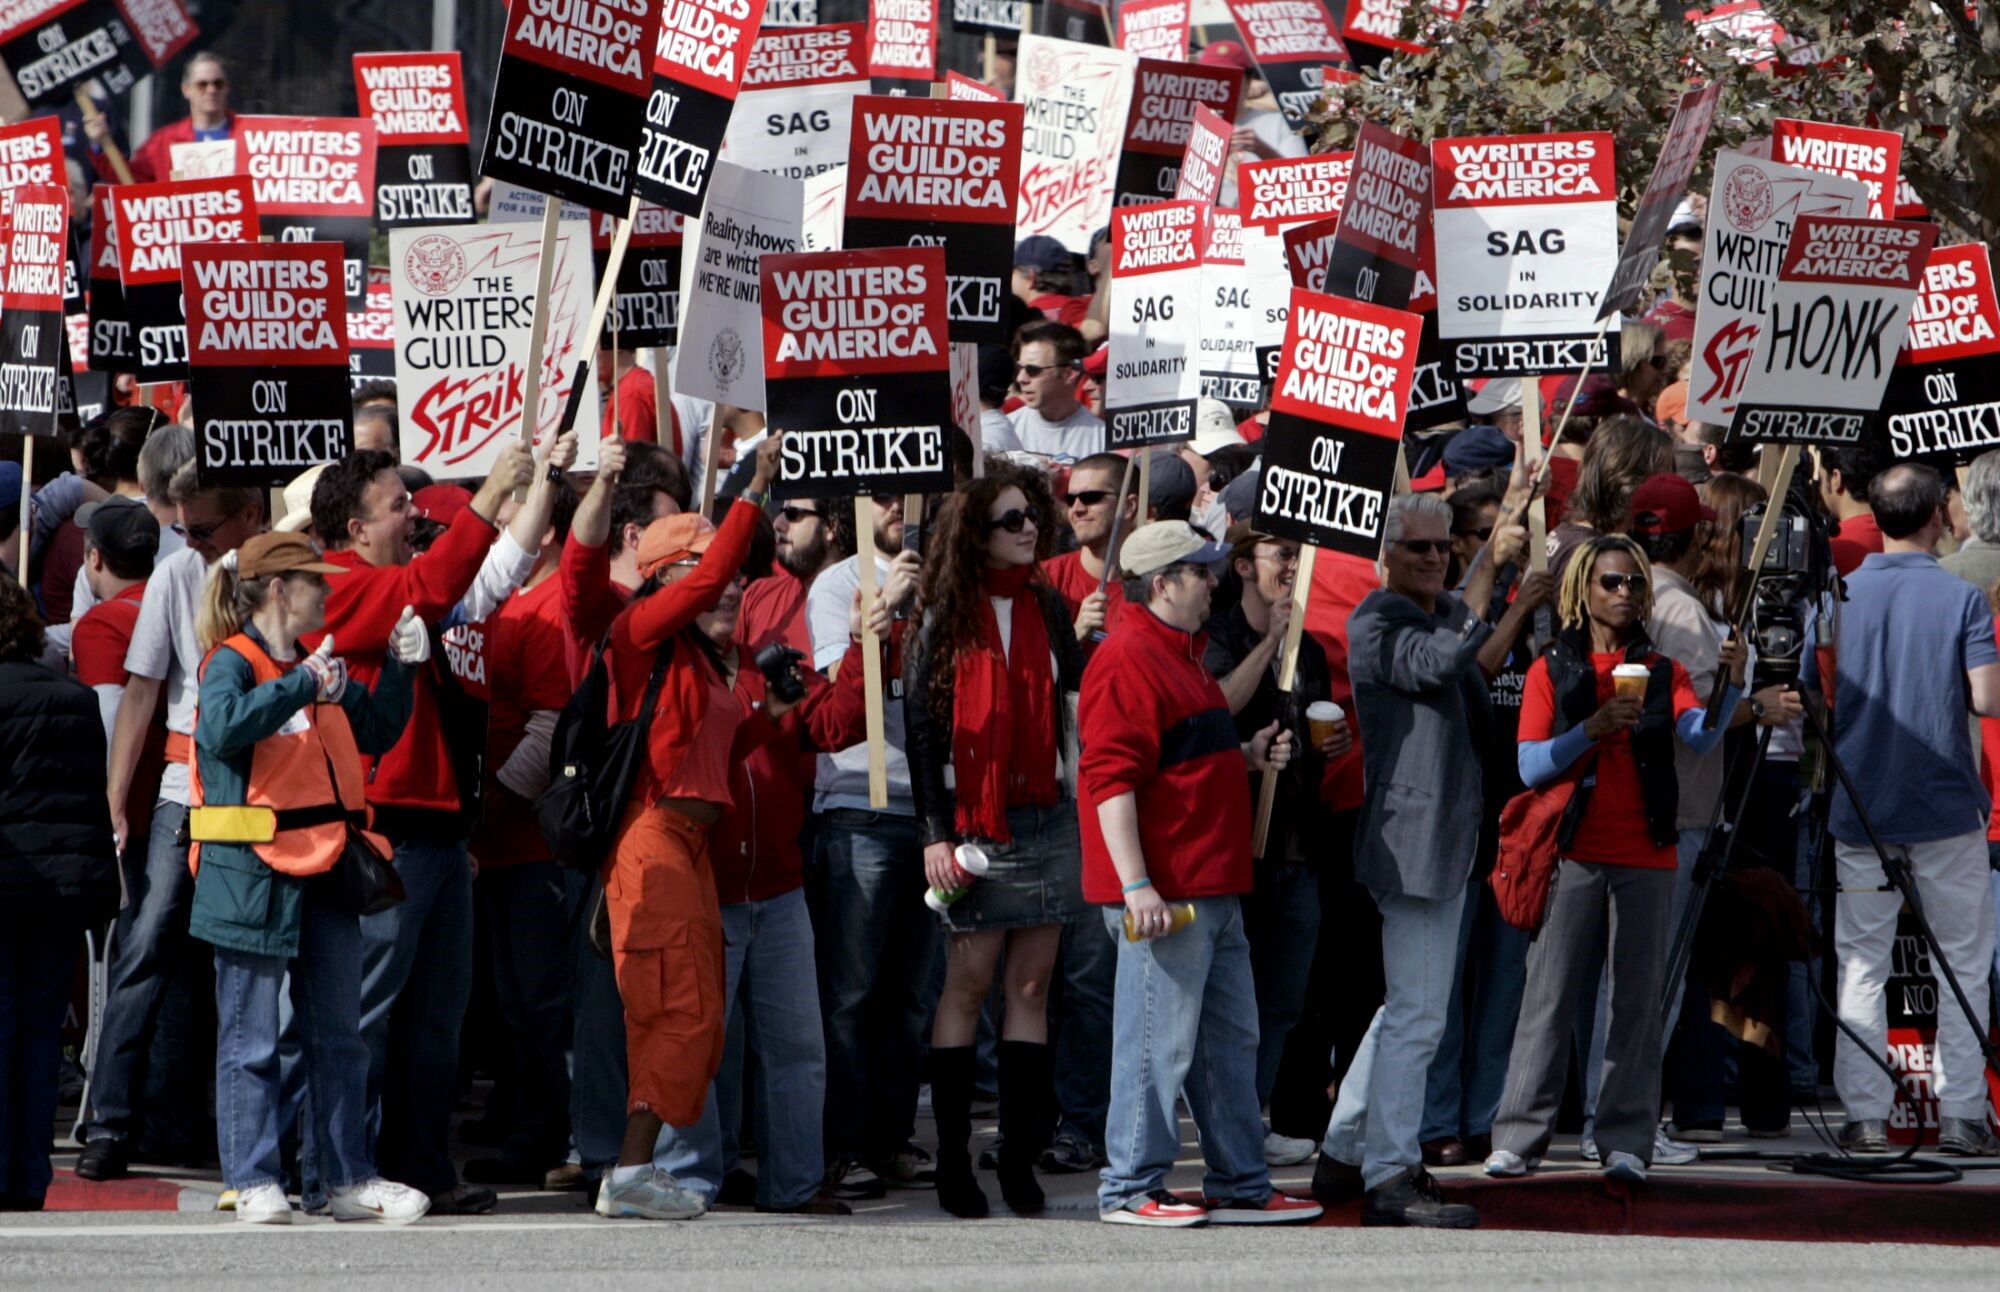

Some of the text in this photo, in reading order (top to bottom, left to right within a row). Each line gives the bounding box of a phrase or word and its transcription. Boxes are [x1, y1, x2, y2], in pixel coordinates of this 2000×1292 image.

[528, 0, 613, 35] GUILD
[613, 20, 642, 46] OF
[1124, 3, 1186, 33] WRITERS
[1234, 1, 1323, 19] WRITERS
[713, 23, 740, 48] OF
[875, 21, 929, 43] GUILD OF
[1124, 27, 1183, 52] GUILD OF
[1249, 16, 1328, 37] GUILD OF
[515, 14, 643, 80] AMERICA
[871, 43, 931, 68] AMERICA
[1256, 33, 1344, 54] AMERICA
[17, 26, 118, 99] STRIKE
[744, 49, 848, 70] GUILD OF
[361, 66, 452, 89] WRITERS
[1141, 71, 1231, 101] WRITERS
[370, 89, 453, 113] GUILD OF
[552, 87, 588, 127] ON
[1063, 85, 1086, 101] THE
[372, 111, 462, 134] AMERICA
[646, 90, 680, 127] ON
[767, 110, 830, 135] SAG
[1023, 95, 1097, 134] WRITERS
[244, 131, 361, 156] WRITERS
[864, 113, 1005, 149] WRITERS
[1022, 126, 1076, 160] GUILD
[495, 112, 630, 196] STRIKE
[868, 144, 1000, 177] GUILD OF
[1450, 139, 1596, 163] WRITERS
[1782, 135, 1887, 174] WRITERS
[29, 163, 52, 184] OF
[249, 155, 357, 179] GUILD OF
[408, 154, 434, 180] ON
[1361, 139, 1431, 195] WRITERS
[1454, 160, 1590, 182] GUILD OF
[379, 184, 472, 221] STRIKE
[509, 191, 544, 203] ACTING
[856, 174, 1007, 208] AMERICA
[1253, 181, 1333, 201] GUILD
[1355, 172, 1422, 222] GUILD OF
[1448, 177, 1600, 200] AMERICA
[13, 203, 63, 233] WRITERS
[121, 190, 243, 223] WRITERS
[497, 202, 517, 213] FOR
[1121, 205, 1196, 232] WRITERS
[131, 219, 243, 247] GUILD OF
[705, 211, 796, 254] Reality shows
[1123, 228, 1193, 251] GUILD OF
[1344, 200, 1418, 254] AMERICA
[1807, 223, 1920, 247] WRITERS
[12, 233, 60, 264] GUILD OF
[704, 247, 722, 266] are
[1119, 242, 1196, 270] AMERICA
[1486, 228, 1566, 257] SAG
[1804, 242, 1909, 264] GUILD OF
[7, 264, 60, 294] AMERICA
[193, 260, 328, 290] WRITERS
[473, 276, 513, 293] THE
[640, 259, 667, 286] ON
[699, 269, 731, 298] WE'RE
[773, 264, 928, 300] WRITERS
[1355, 266, 1380, 303] ON
[1519, 271, 1536, 282] IN
[1791, 258, 1911, 281] AMERICA
[203, 291, 326, 320] GUILD OF
[782, 299, 924, 331] GUILD OF
[1132, 295, 1174, 323] SAG
[1457, 291, 1600, 312] SOLIDARITY
[1952, 294, 1979, 316] OF
[21, 325, 40, 358] ON
[199, 321, 339, 350] AMERICA
[775, 326, 938, 363] AMERICA
[1146, 338, 1155, 349] IN
[1297, 306, 1406, 360] WRITERS
[1765, 295, 1899, 381] HONK
[404, 334, 506, 369] GUILD
[1293, 339, 1370, 383] GUILD
[1369, 363, 1398, 388] OF
[1455, 338, 1608, 373] STRIKE
[1116, 357, 1188, 380] SOLIDARITY
[0, 362, 55, 413] STRIKE
[252, 380, 287, 413] ON
[1281, 368, 1397, 423] AMERICA
[1924, 372, 1958, 405] ON
[836, 388, 877, 423] ON
[1112, 405, 1191, 443] STRIKE
[1740, 410, 1865, 443] STRIKE
[204, 419, 346, 467] STRIKE
[780, 425, 944, 481] STRIKE
[1310, 435, 1345, 475] ON
[1260, 464, 1383, 539] STRIKE
[468, 629, 484, 653] OF
